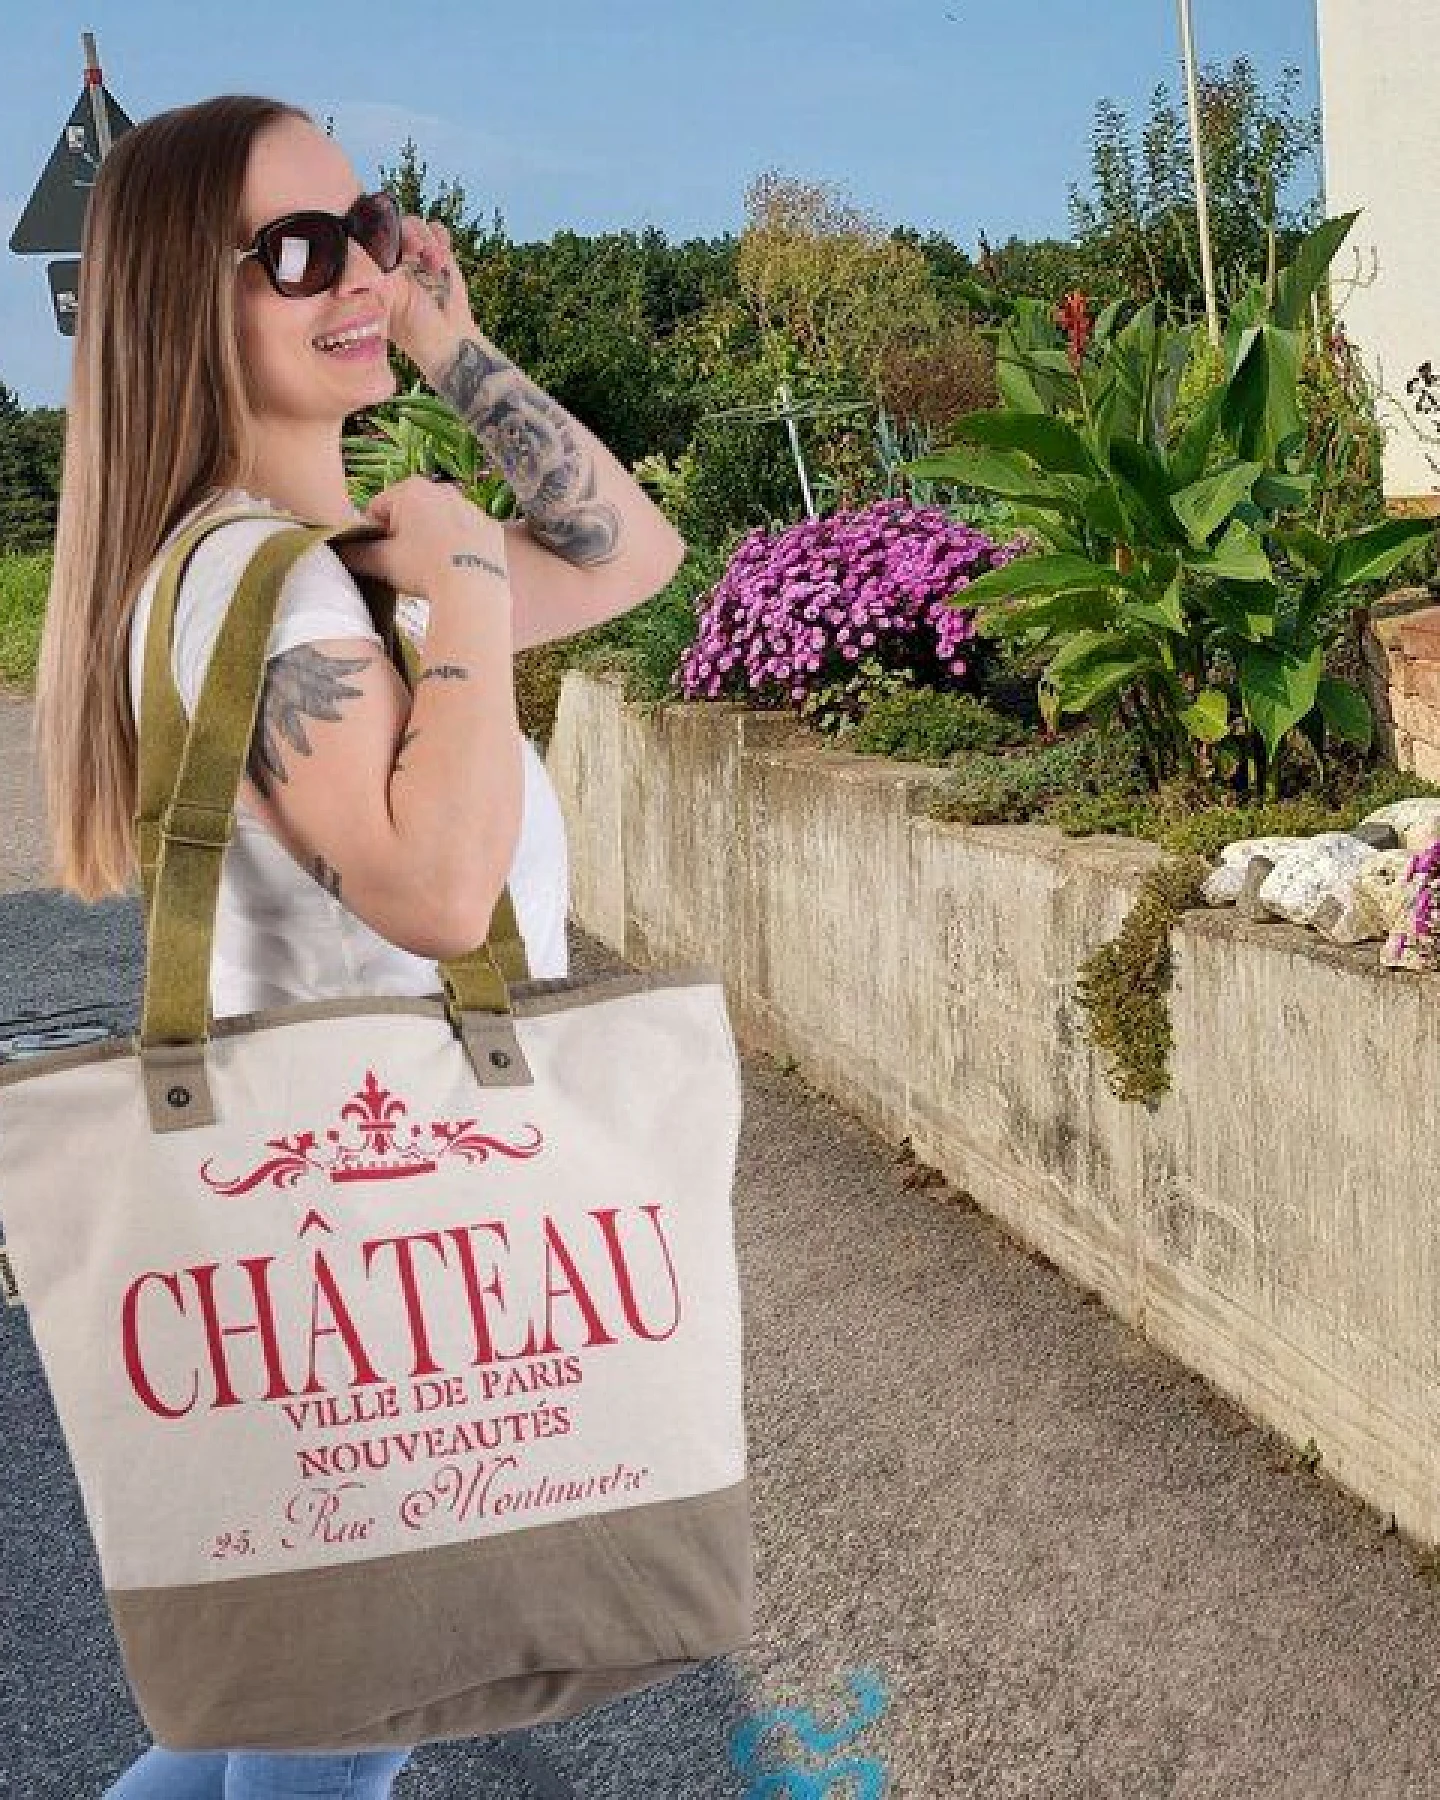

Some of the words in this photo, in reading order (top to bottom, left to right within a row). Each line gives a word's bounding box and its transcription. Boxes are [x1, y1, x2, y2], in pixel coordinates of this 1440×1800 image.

[121, 1205, 682, 1420] CHÂTEAU
[283, 1382, 400, 1432] VILLE
[412, 1379, 469, 1411] DE
[481, 1355, 584, 1402] PARIS
[297, 1402, 572, 1479] NOUVEAUTÉS
[281, 1481, 374, 1551] Rue
